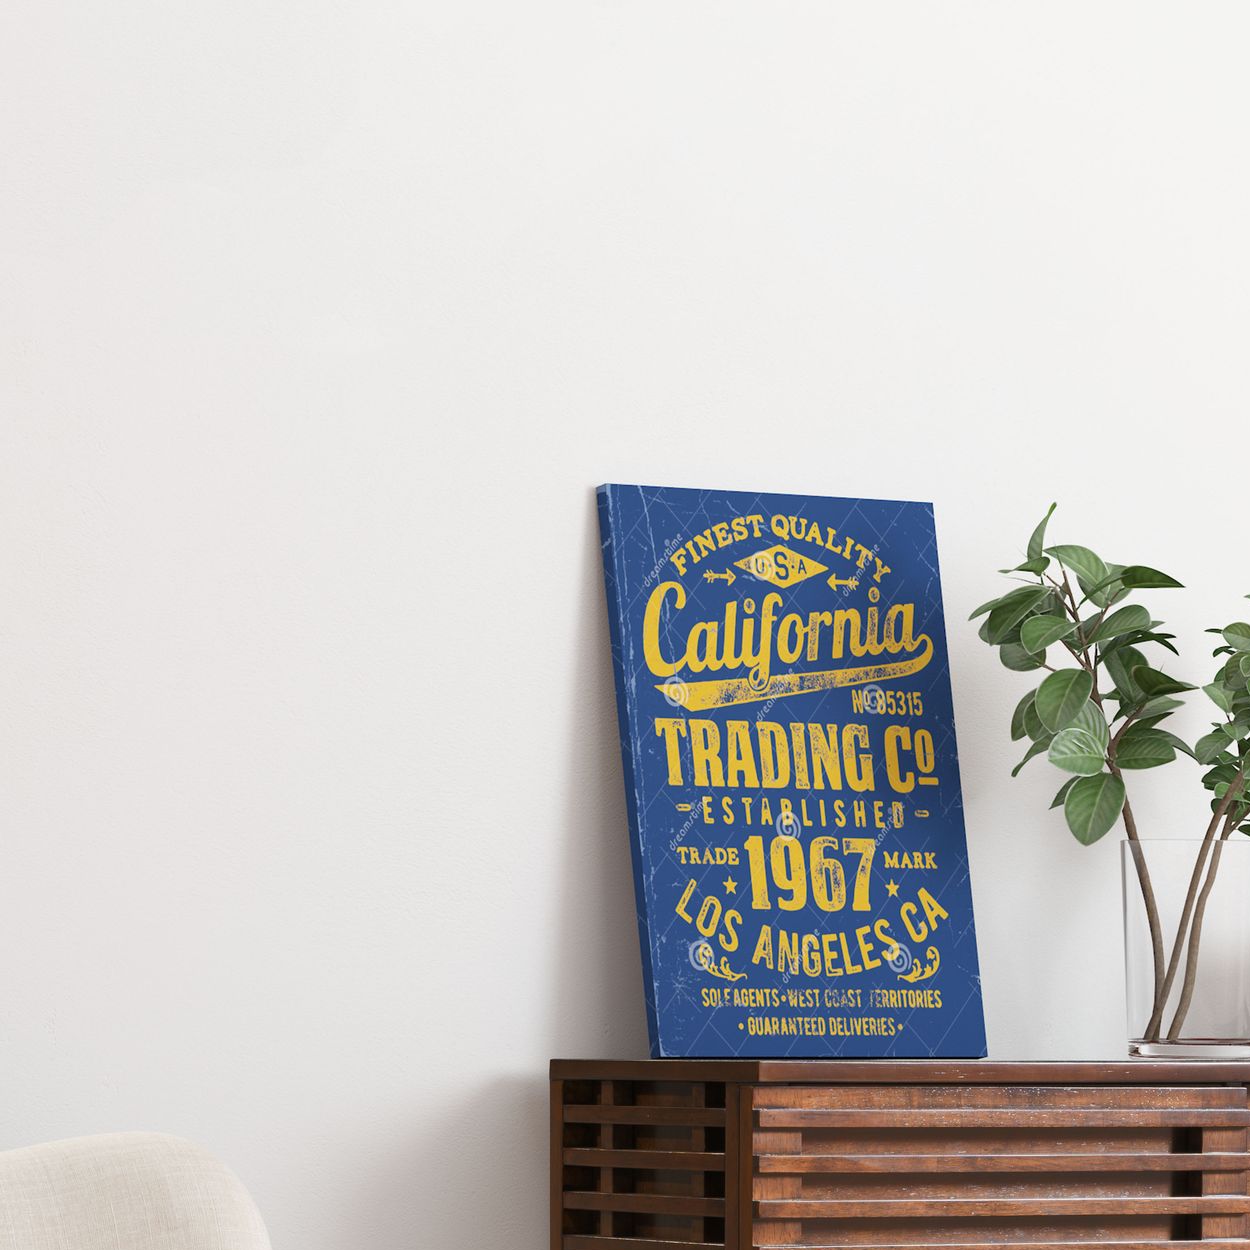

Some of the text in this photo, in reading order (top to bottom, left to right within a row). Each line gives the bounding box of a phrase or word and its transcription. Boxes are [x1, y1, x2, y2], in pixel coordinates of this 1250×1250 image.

[670, 514, 892, 583] FINEST QUALITY
[643, 580, 934, 690] California
[876, 690, 924, 716] 85315
[654, 717, 876, 793] TRADING
[702, 796, 905, 829] ESTABLISHED
[676, 835, 938, 912] TRADE 1967 MARK
[675, 878, 949, 977] LOS ANGELES CA
[748, 1016, 896, 1037] GUARANTEED DELIVERIES
[824, 989, 862, 1008] COAST
[869, 989, 943, 1009] TERRITORIES
